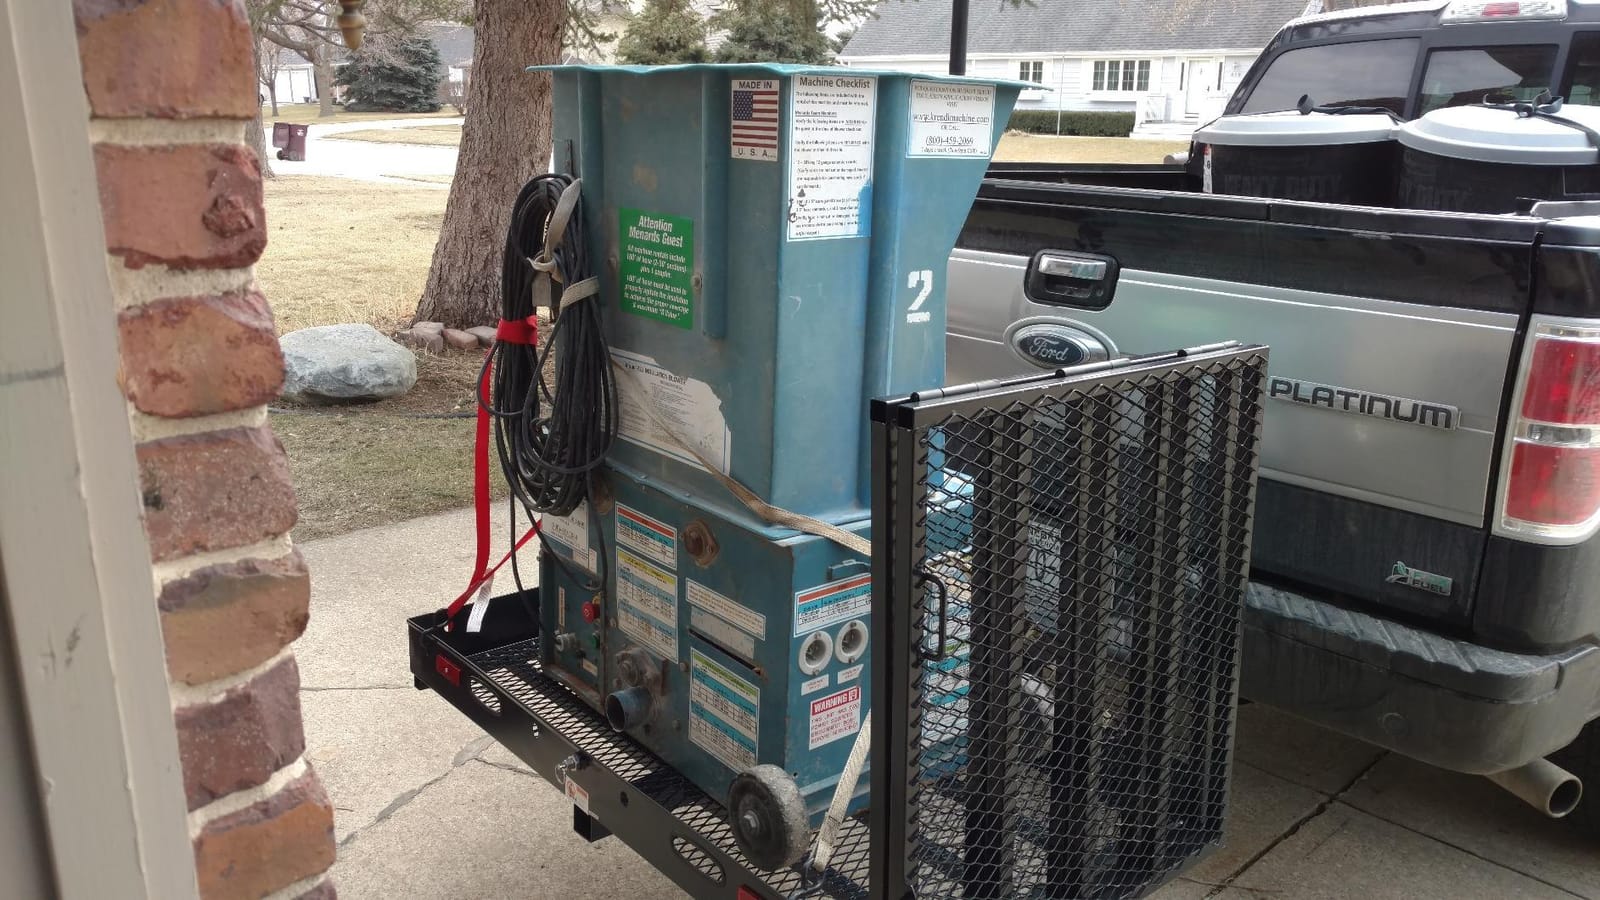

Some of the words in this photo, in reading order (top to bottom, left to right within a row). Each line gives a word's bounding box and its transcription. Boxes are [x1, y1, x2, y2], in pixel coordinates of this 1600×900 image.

[739, 81, 760, 89] MADE
[763, 81, 772, 89] IN
[799, 77, 833, 87] Machine
[836, 78, 870, 88] Checklist
[638, 215, 673, 232] Attention
[629, 226, 660, 243] Menards
[661, 232, 684, 248] Guest
[906, 269, 933, 323] 2
[1028, 336, 1069, 361] Ford
[1270, 378, 1452, 429] PLATINUM
[1412, 578, 1447, 593] FUEL
[813, 691, 848, 713] WARNING
